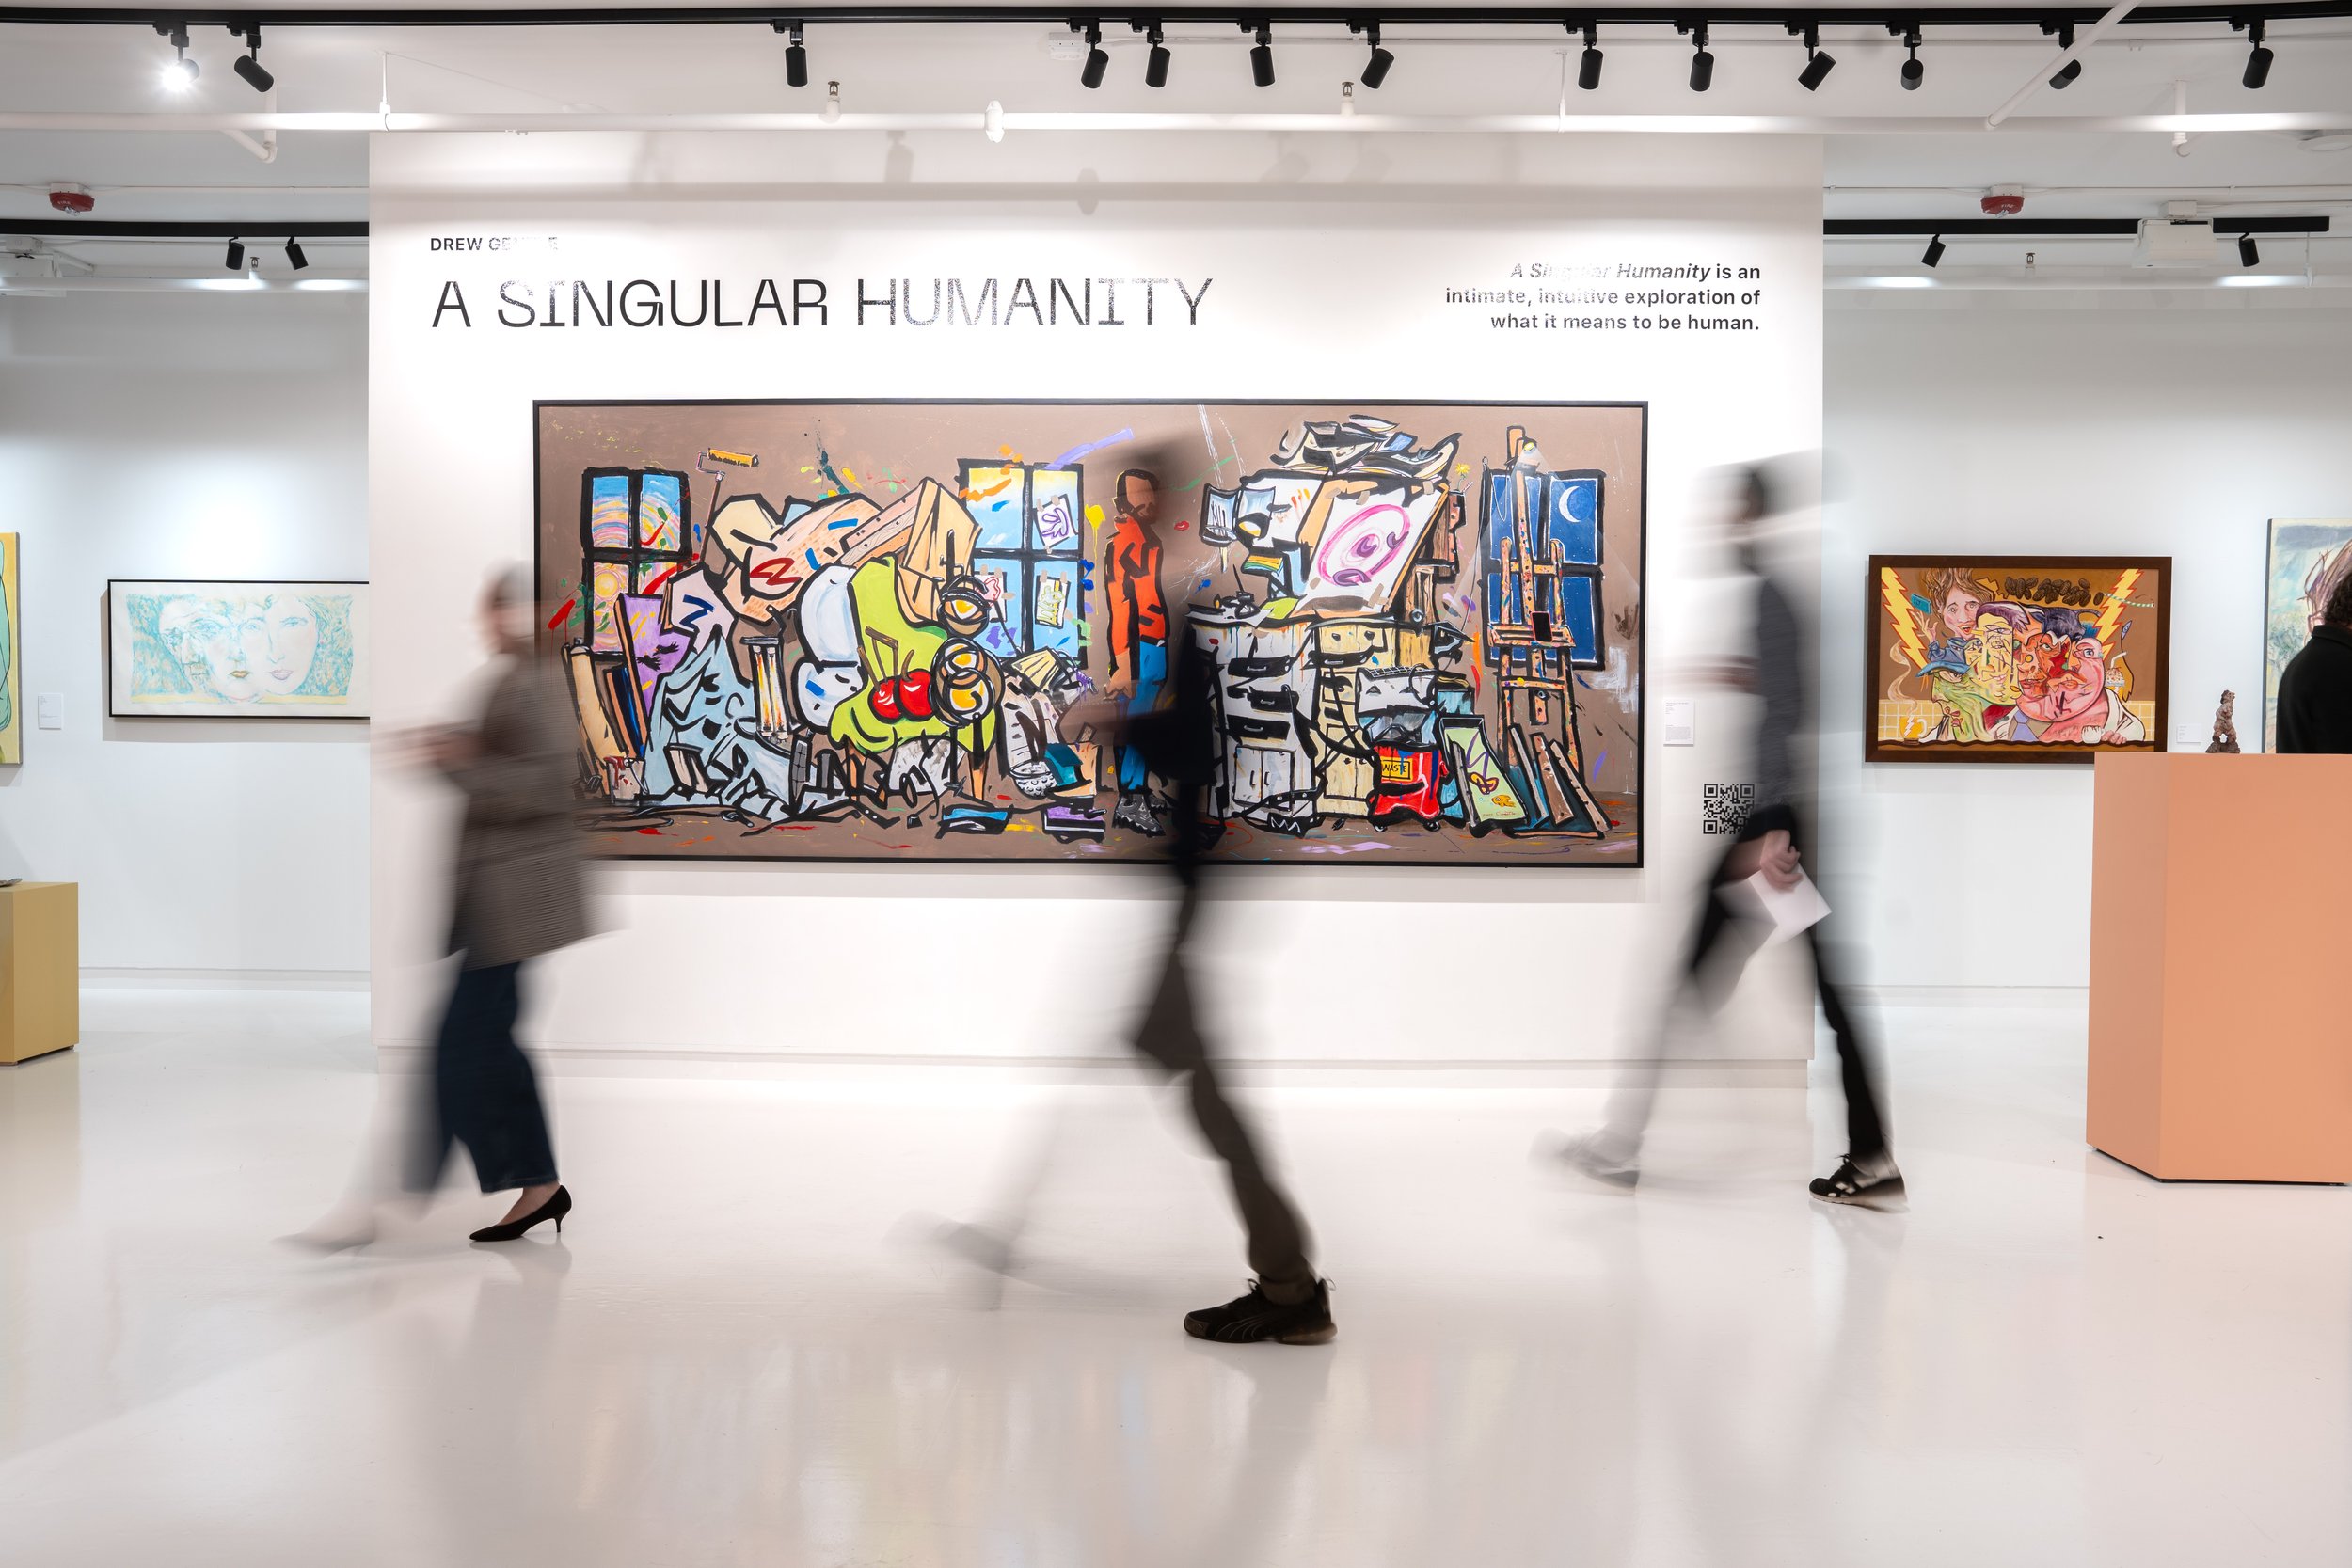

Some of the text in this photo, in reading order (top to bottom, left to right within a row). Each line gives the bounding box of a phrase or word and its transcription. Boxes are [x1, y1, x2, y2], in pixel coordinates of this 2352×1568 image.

[430, 237, 483, 251] DREW
[1510, 263, 1523, 278] A
[1616, 263, 1712, 283] Humanity
[1717, 263, 1732, 279] is
[1737, 267, 1761, 279] an
[431, 278, 1214, 328] A SINGULAR HUMANITY
[1446, 287, 1761, 307] intimate, intuitive exploration of
[1490, 312, 1760, 331] what it means to be human.
